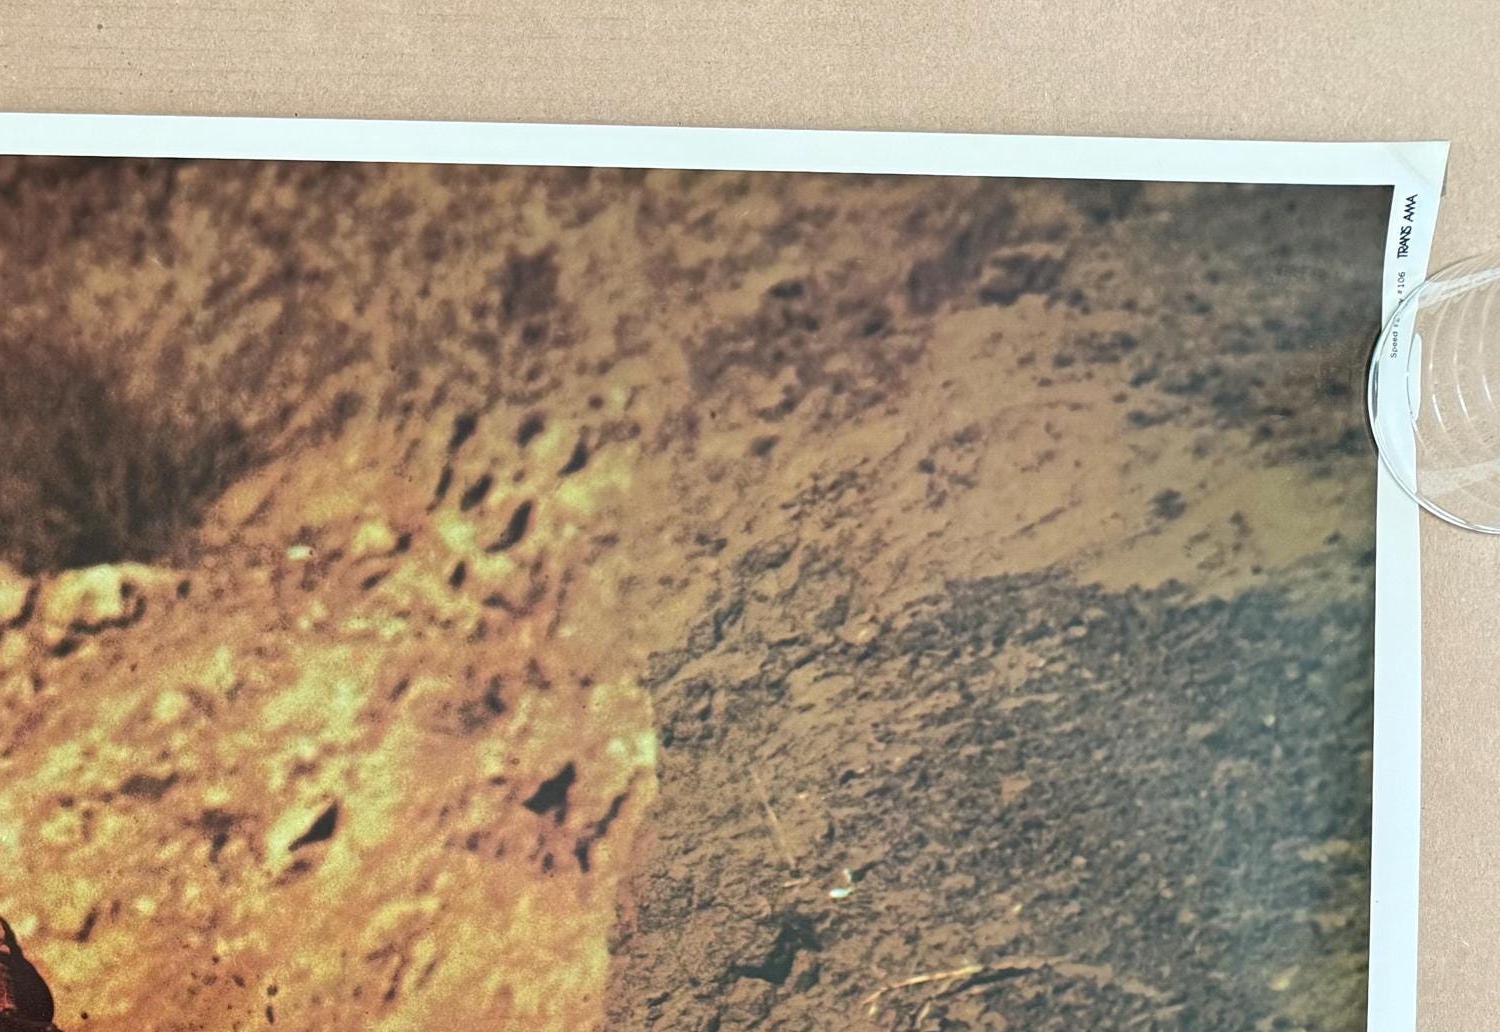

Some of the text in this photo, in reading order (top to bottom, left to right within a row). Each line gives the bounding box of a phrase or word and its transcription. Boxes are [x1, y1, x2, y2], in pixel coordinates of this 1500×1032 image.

[1396, 193, 1418, 259] TRANS AMA
[1390, 330, 1400, 359] Speed
[1397, 271, 1406, 294] #106
